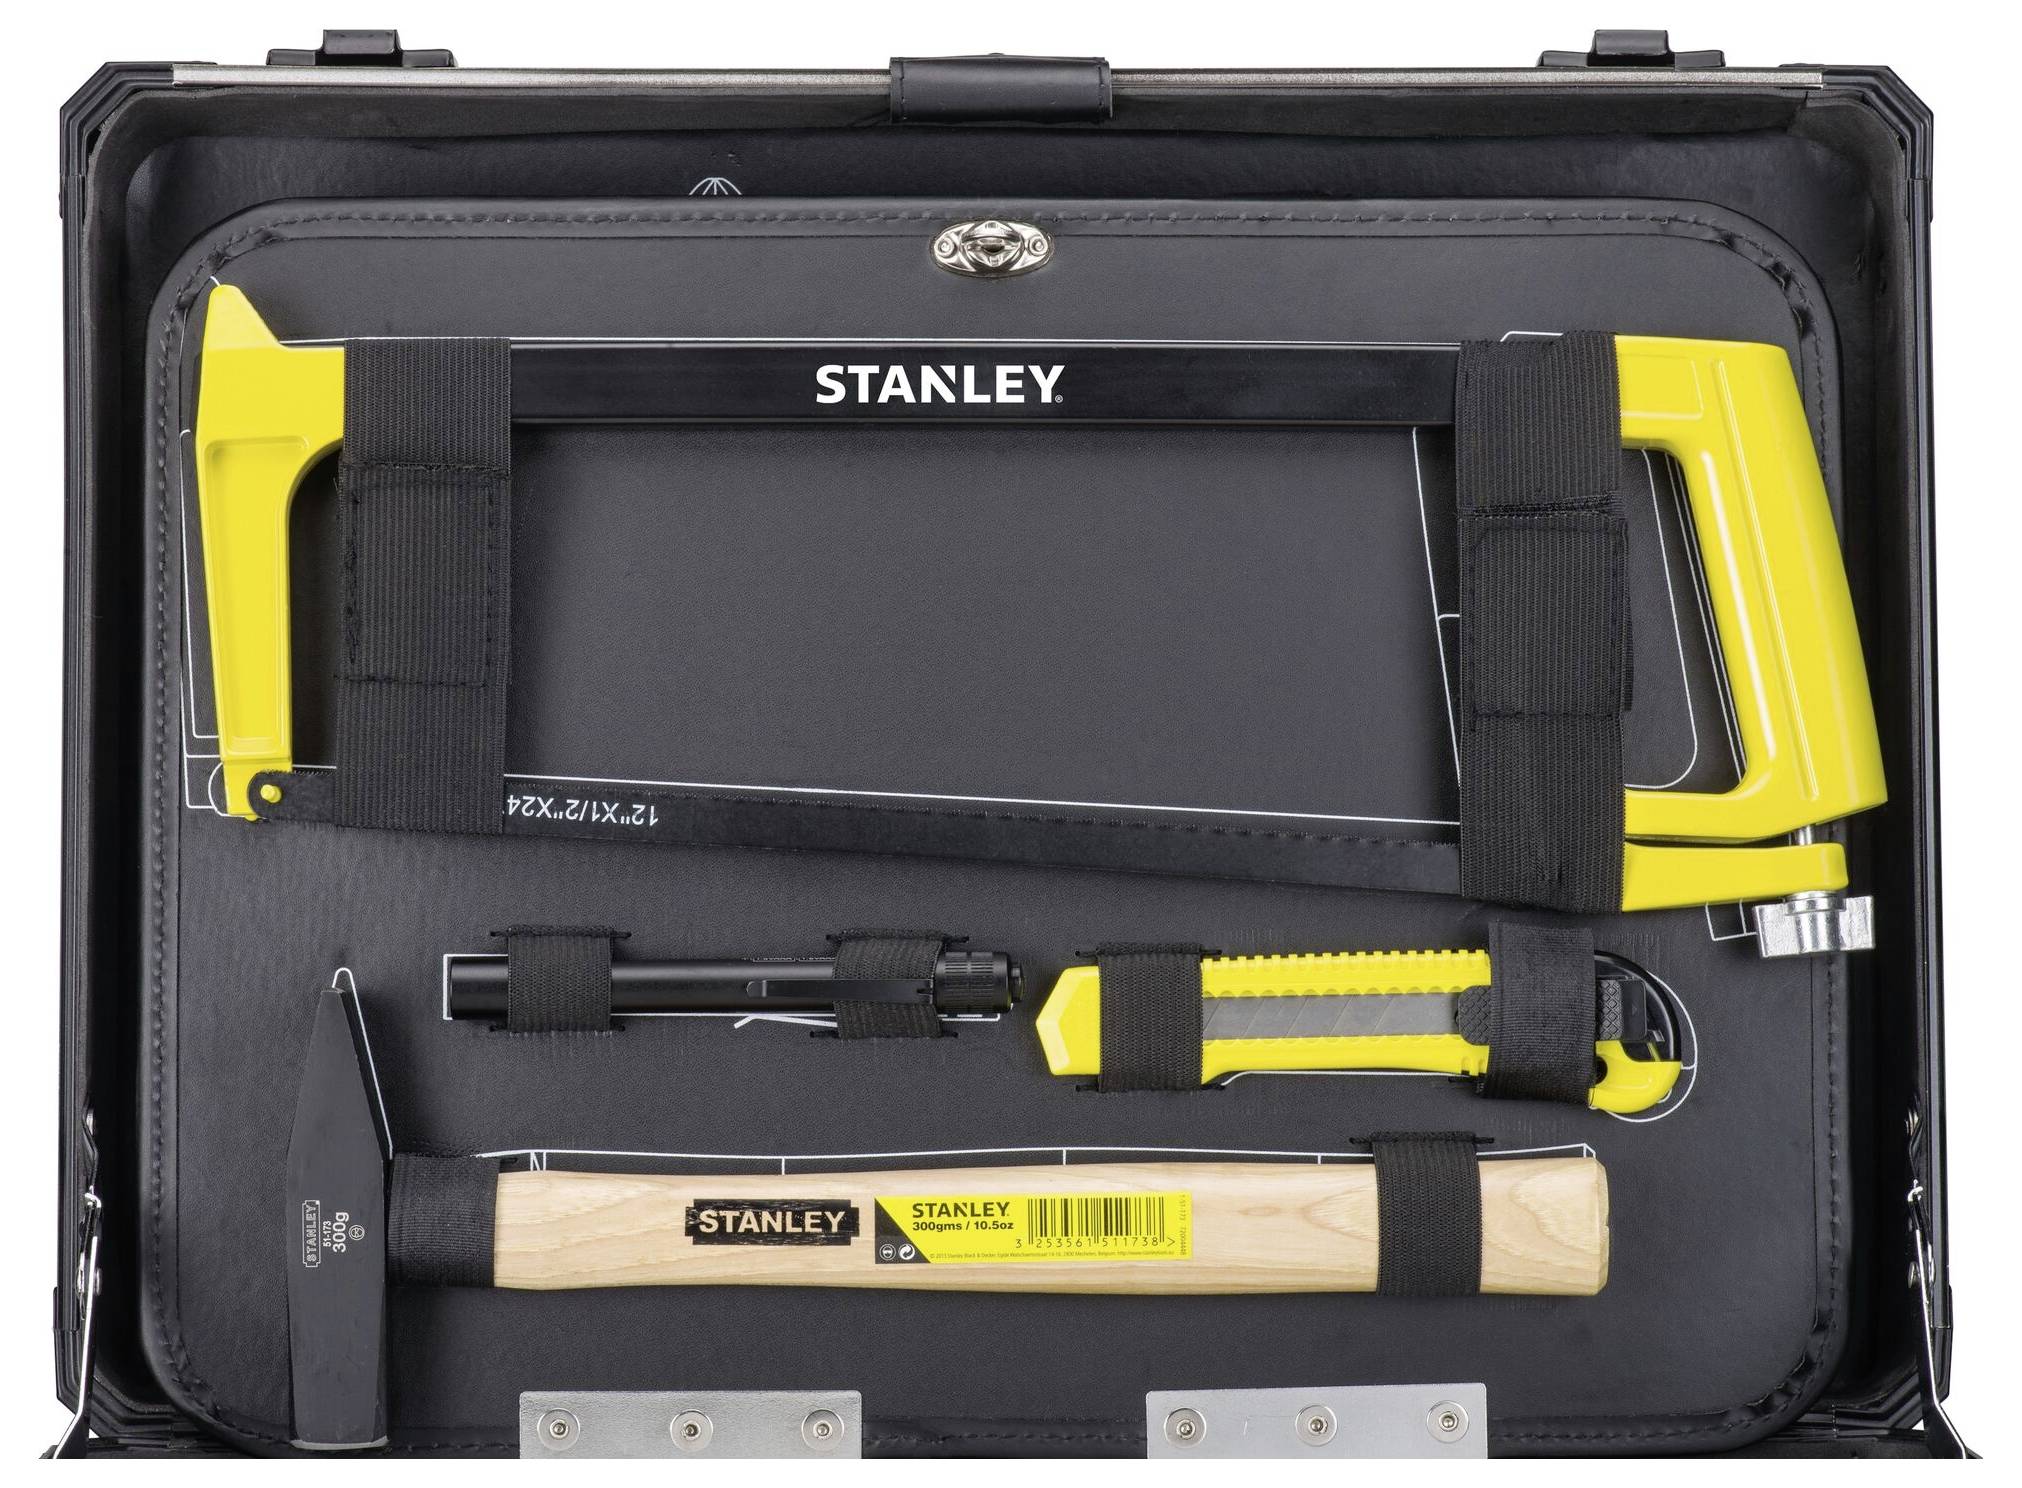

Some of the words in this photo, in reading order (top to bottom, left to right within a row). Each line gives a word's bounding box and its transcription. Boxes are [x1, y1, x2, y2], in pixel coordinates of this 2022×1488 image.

[816, 364, 1065, 404] STANLEY
[502, 795, 659, 827] 12"X1/2"X24
[699, 1209, 846, 1234] STANLEY
[912, 1202, 1010, 1218] STANLEY
[306, 1204, 317, 1262] STANLEY
[322, 1220, 332, 1247] 51-173
[332, 1212, 350, 1253] 300g
[912, 1221, 962, 1232] 300gms
[965, 1221, 970, 1231] /
[974, 1220, 1014, 1231] 10.5oz
[1016, 1238, 1022, 1249] 3
[1036, 1237, 1092, 1249] 253561
[1102, 1236, 1158, 1247] 511738
